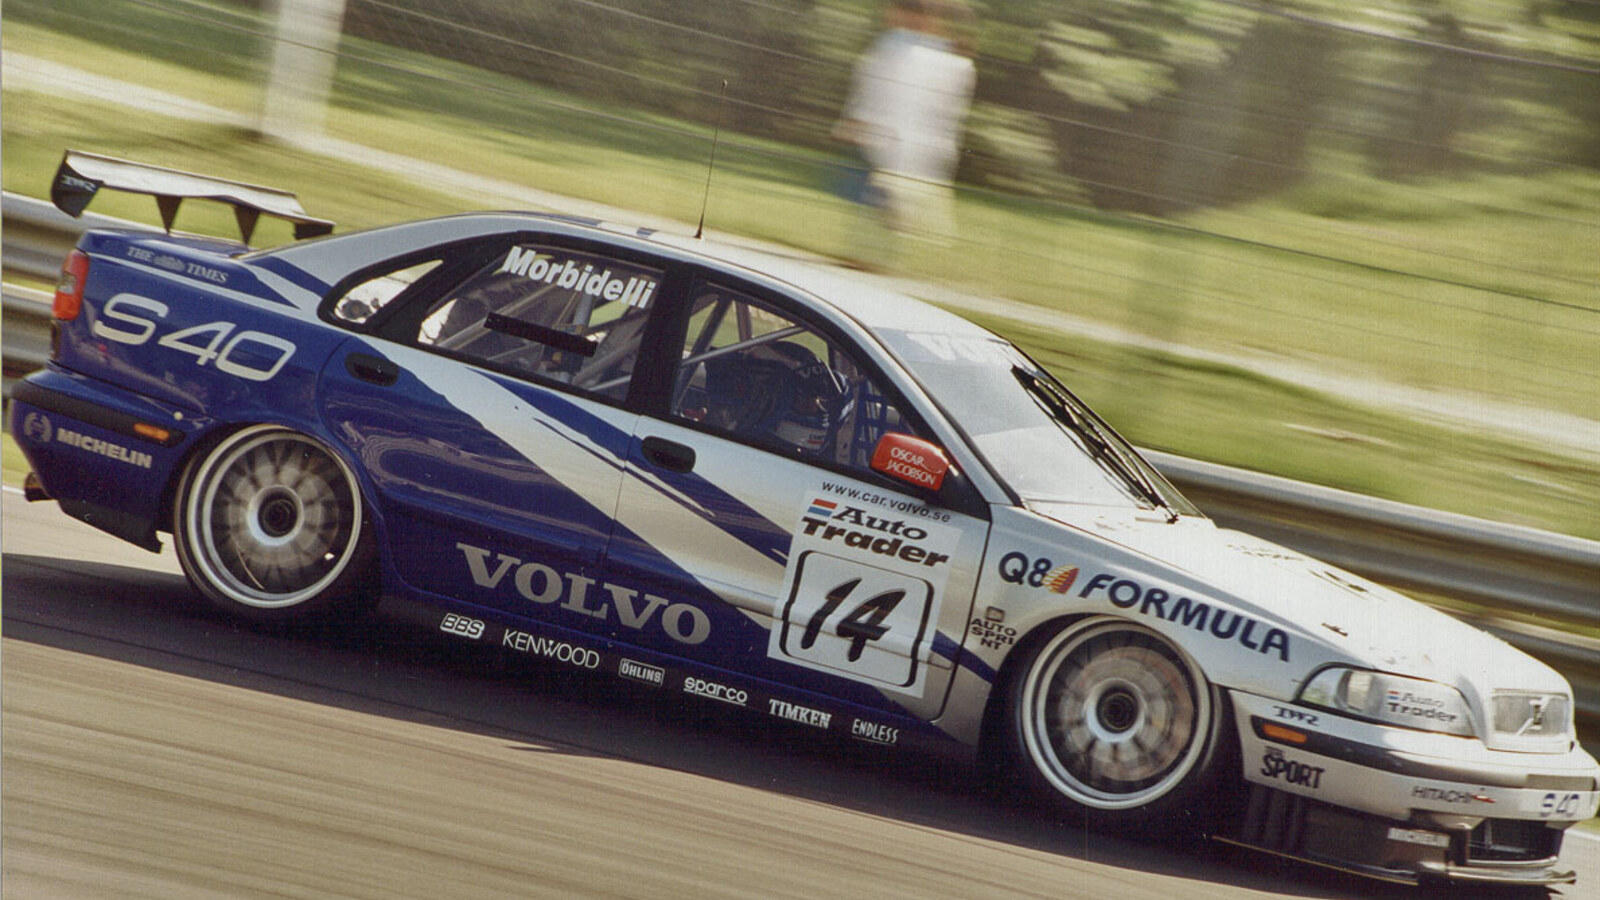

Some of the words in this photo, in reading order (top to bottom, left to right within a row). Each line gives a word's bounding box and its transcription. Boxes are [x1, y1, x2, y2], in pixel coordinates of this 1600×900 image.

[127, 246, 155, 262] THE
[187, 263, 228, 283] TIMES
[502, 246, 655, 309] Morbidelli
[56, 427, 153, 469] MICHELIN
[890, 447, 924, 467] OSCAR
[886, 459, 936, 486] JACOBSON
[821, 481, 951, 524] www.car.volvo.se
[833, 505, 928, 540] Auto
[801, 516, 949, 567] Trader
[456, 542, 711, 645] VOLVO
[999, 551, 1052, 588] Q8
[1078, 573, 1290, 662] FORMULA
[442, 615, 483, 637] BBS
[801, 577, 907, 663] 14
[970, 618, 1017, 637] AUTO
[502, 629, 600, 669] KENWOOD
[971, 627, 1015, 646] SPRI
[980, 638, 1003, 651] NT
[620, 661, 662, 684] ÖHLINS
[684, 677, 748, 704] sparco
[769, 699, 832, 729] TIMKEN
[1388, 701, 1457, 722] Trader
[851, 719, 899, 745] ENDLESS
[1260, 753, 1325, 790] SPORT
[1412, 785, 1472, 804] HITACHI
